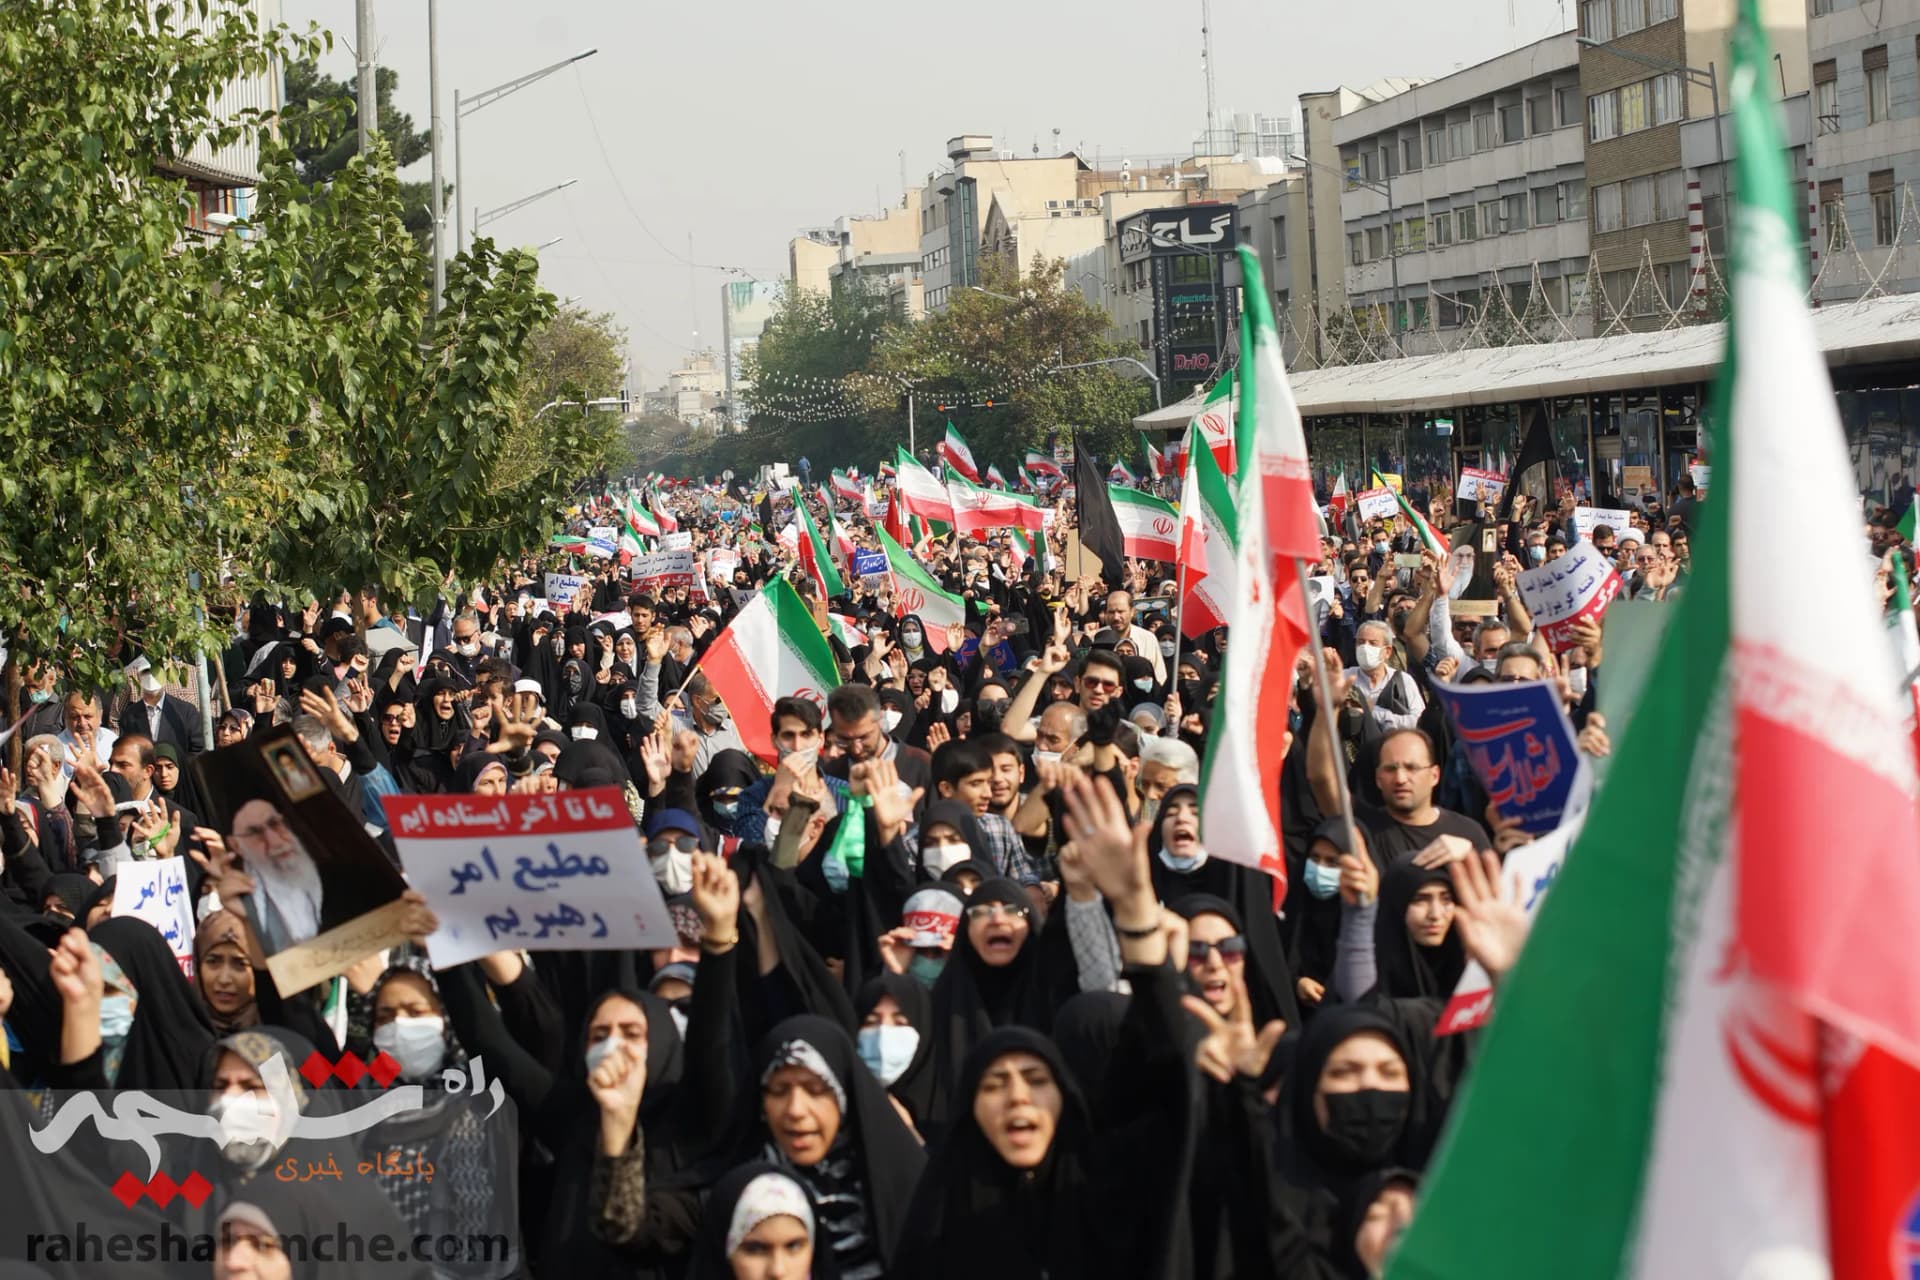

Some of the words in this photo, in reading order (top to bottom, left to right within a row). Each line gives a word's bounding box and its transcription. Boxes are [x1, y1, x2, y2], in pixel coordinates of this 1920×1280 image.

[1151, 212, 1231, 247] گاج
[400, 802, 429, 833] ایم
[433, 800, 510, 829] ایستاده
[520, 795, 559, 831] آخر
[565, 798, 586, 819] تا
[591, 796, 614, 819] ما
[449, 845, 499, 895] امر
[512, 842, 610, 892] مطیع
